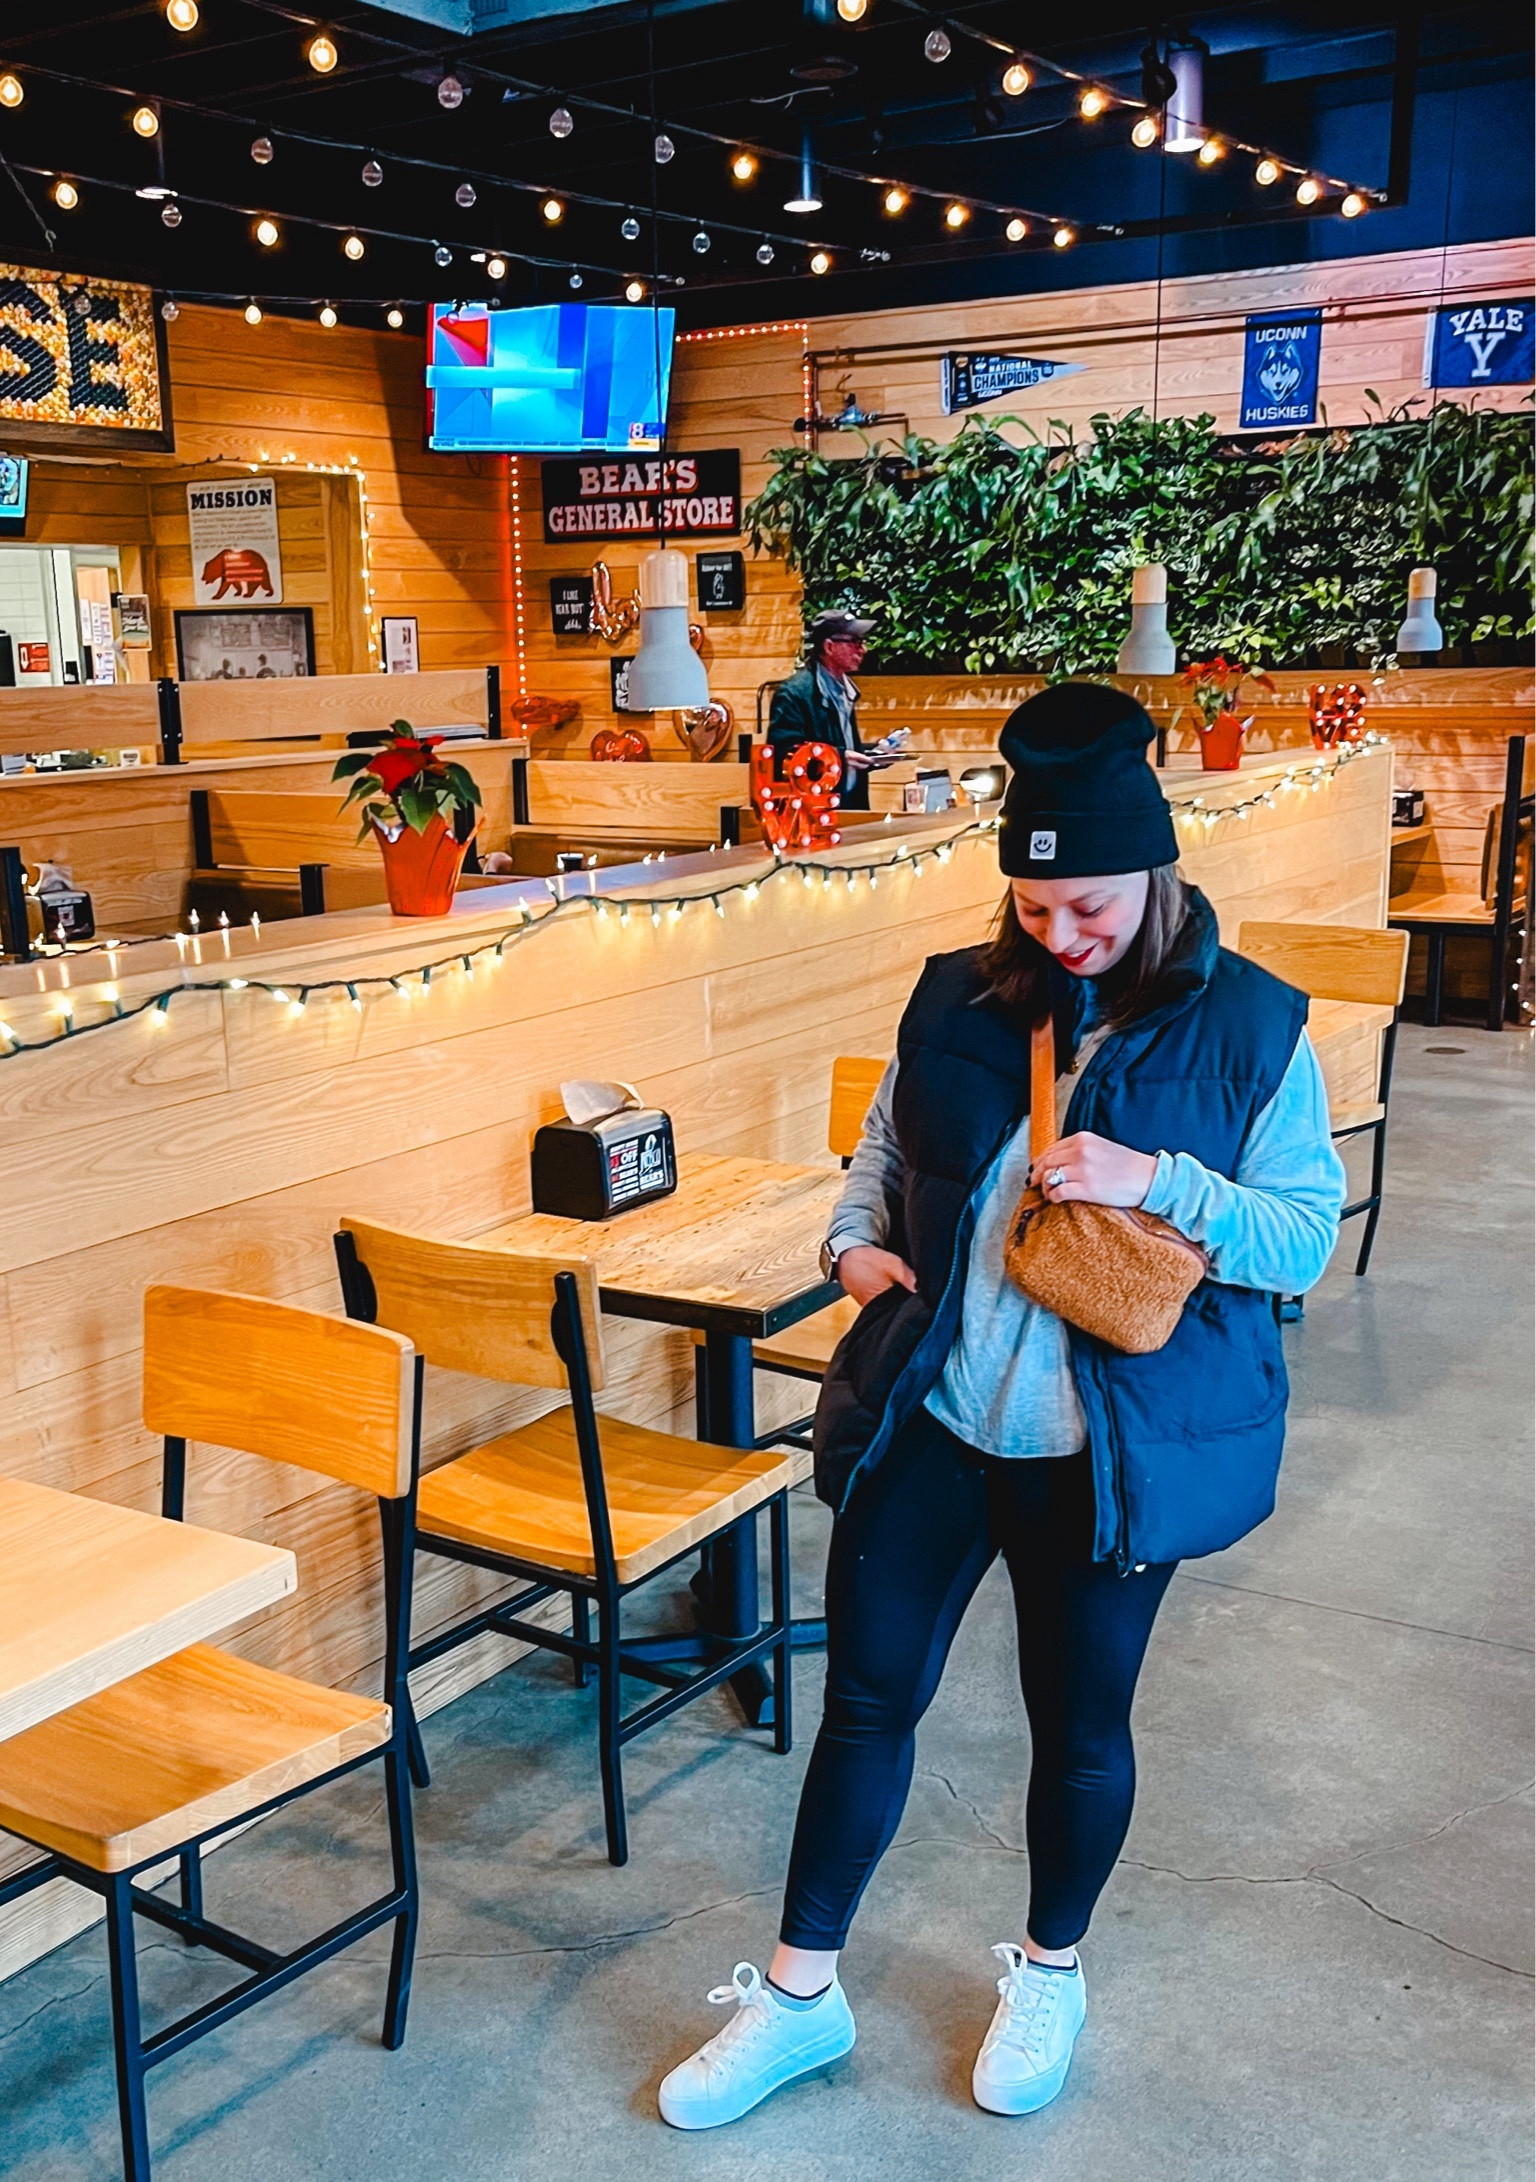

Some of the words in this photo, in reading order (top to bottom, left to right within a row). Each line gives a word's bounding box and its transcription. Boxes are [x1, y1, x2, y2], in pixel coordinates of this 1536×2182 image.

[1449, 307, 1524, 336] YALE
[1255, 326, 1307, 343] UCONN
[1464, 331, 1506, 378] Y
[974, 369, 1040, 390] CHAMPIONS
[1245, 404, 1309, 421] HUSKIES
[632, 422, 644, 438] 8
[579, 458, 697, 496] BEAR'S
[190, 489, 272, 510] MISSION
[548, 500, 655, 533] GENERAL
[658, 496, 734, 528] STORE
